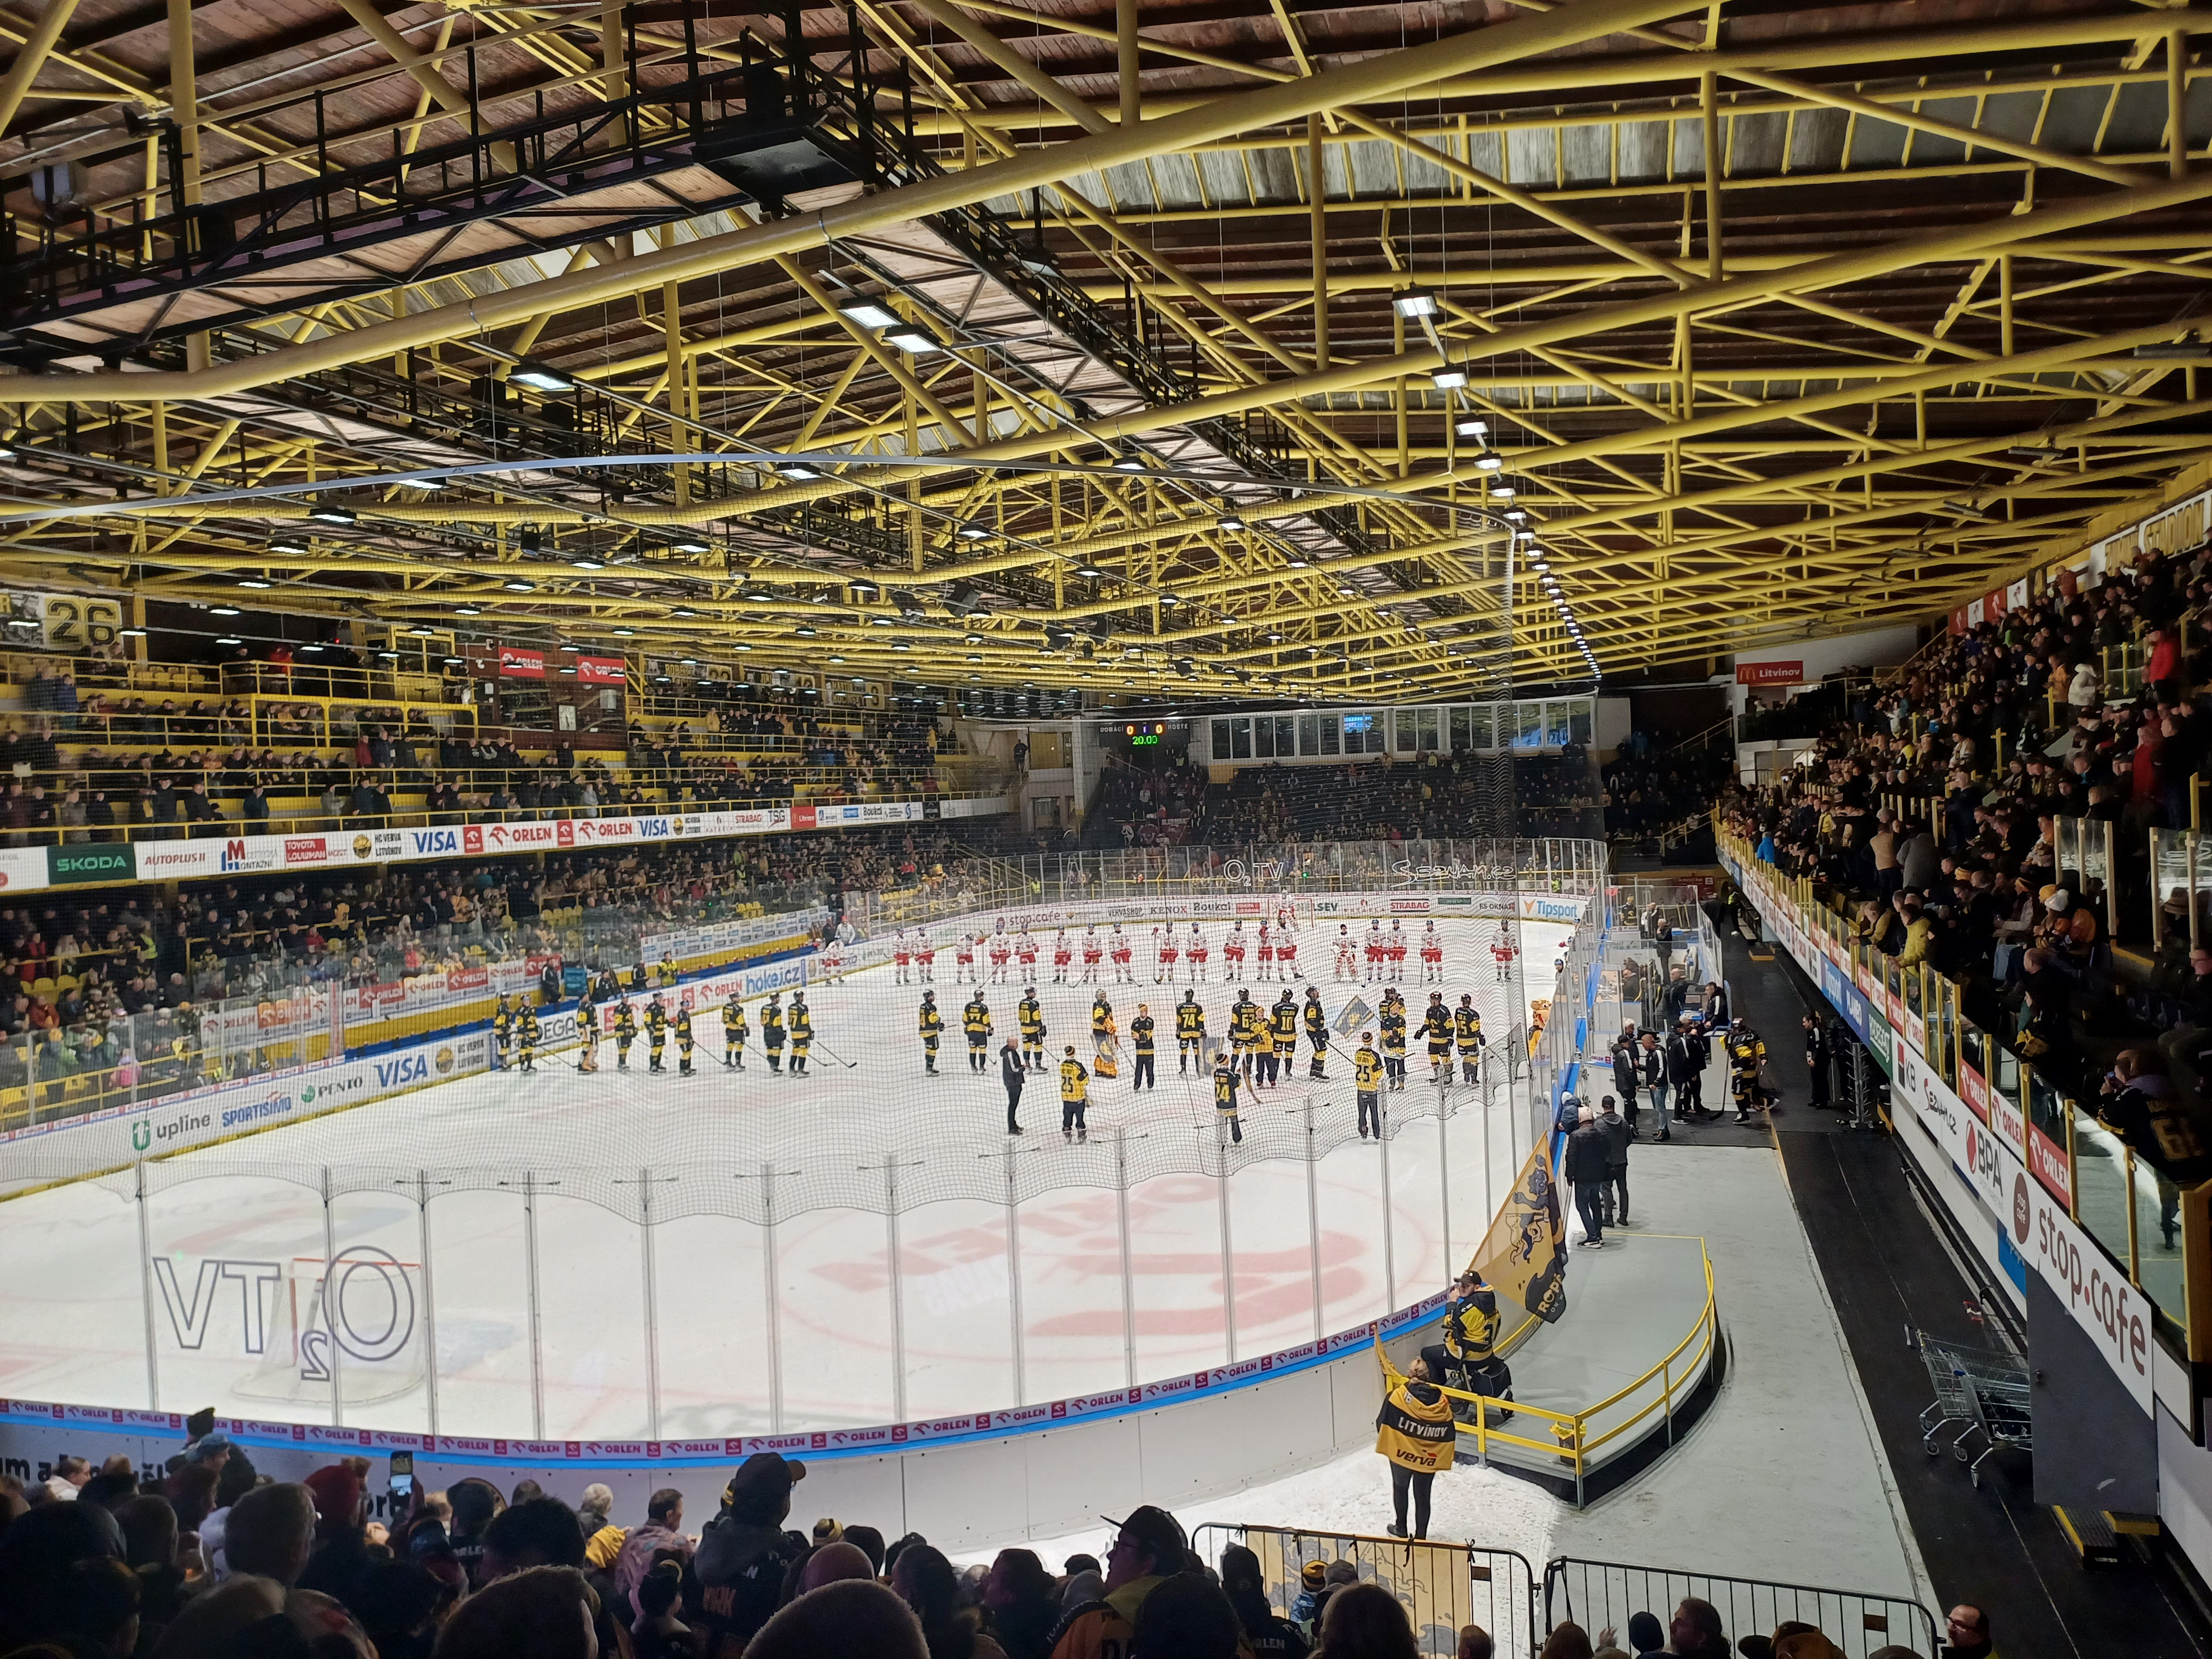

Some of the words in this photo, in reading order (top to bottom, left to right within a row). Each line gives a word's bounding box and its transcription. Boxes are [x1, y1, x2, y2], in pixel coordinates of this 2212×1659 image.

[48, 599, 117, 645] 26
[1156, 724, 1162, 734] 0
[735, 815, 762, 823] STRABAG
[768, 811, 785, 822] TSG
[513, 827, 551, 842] ORLEN
[599, 823, 632, 837] ORLEN
[638, 820, 668, 837] VISA
[286, 841, 316, 850] TOYOTA
[411, 831, 457, 853] VISA
[145, 854, 197, 865] AUTOPLUS
[1253, 862, 1284, 881] TV
[1108, 907, 1142, 916] VERVASHOP
[1150, 906, 1187, 914] KENOX
[1194, 902, 1231, 911] Boukal
[1391, 901, 1430, 910] STRABAG
[1536, 900, 1577, 919] Tipsport
[1010, 911, 1061, 926] stop.cafe
[501, 967, 523, 977] ORLEN
[746, 967, 800, 994] hokej.cz
[1825, 961, 1842, 1005] Tipsport
[715, 980, 742, 996] ORLEN
[1182, 1014, 1195, 1028] 74
[1281, 1016, 1293, 1031] 10
[373, 1054, 428, 1087] VISA
[1356, 1065, 1370, 1082] 25
[1906, 1058, 1916, 1093] KB
[1970, 1078, 1987, 1112] ORLEN
[222, 1097, 291, 1127] SPORTISIMO
[156, 1114, 210, 1140] upline
[2003, 1110, 2025, 1149] ORLEN
[1978, 1129, 2003, 1198] BPA
[2043, 1149, 2069, 1193] ORLEN
[2017, 1193, 2026, 1211] stop
[2016, 1206, 2026, 1225] cafe
[2039, 1207, 2146, 1376] stop.cafe
[1431, 1293, 1447, 1307] ORLEN
[1391, 1311, 1408, 1325] ORLEN
[1343, 1327, 1366, 1343] ORLEN
[1288, 1345, 1313, 1360] ORLEN
[1229, 1361, 1257, 1377] ORLEN
[1162, 1379, 1190, 1392] ORLEN
[1090, 1394, 1123, 1407] ORLEN
[25, 1403, 48, 1413] ORLEN
[82, 1408, 108, 1418] ORLEN
[1014, 1408, 1046, 1421] ORLEN
[140, 1412, 165, 1423] ORLEN
[261, 1424, 288, 1434] ORLEN
[933, 1419, 970, 1431] ORLEN
[1398, 1416, 1448, 1437] LITVÍNOV
[325, 1430, 355, 1440] ORLEN
[389, 1436, 417, 1446] ORLEN
[851, 1430, 885, 1442] ORLEN
[457, 1440, 489, 1451] ORLEN
[528, 1443, 560, 1453] ORLEN
[605, 1444, 640, 1454] ORLEN
[685, 1442, 719, 1452] ORLEN
[768, 1437, 805, 1449] ORLEN
[1396, 1448, 1437, 1467] verva
